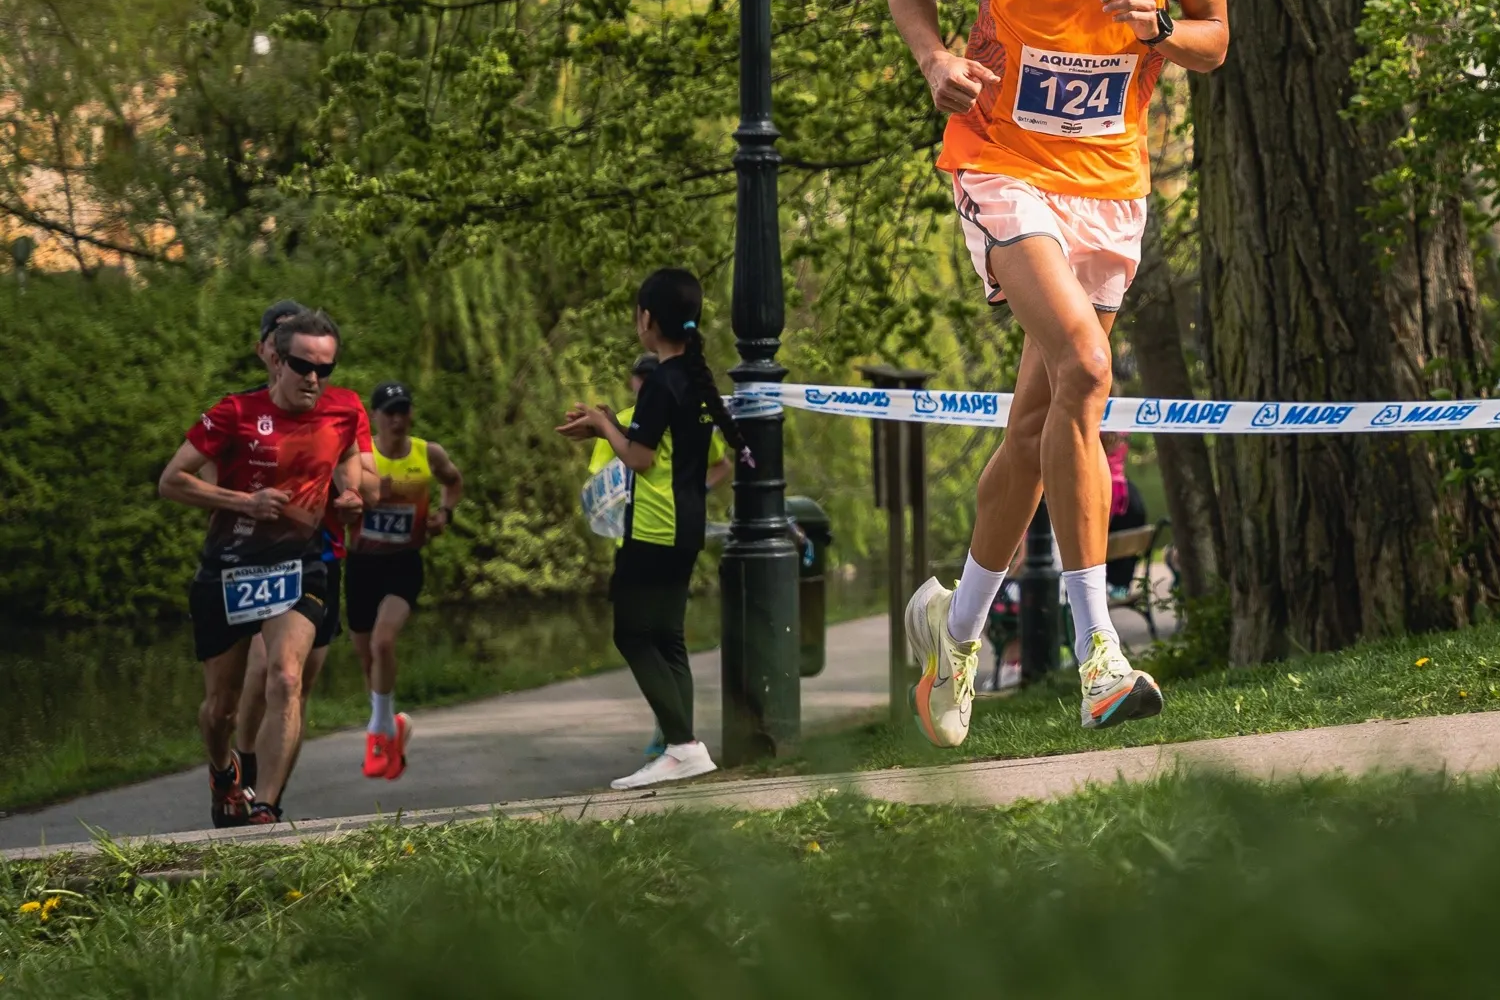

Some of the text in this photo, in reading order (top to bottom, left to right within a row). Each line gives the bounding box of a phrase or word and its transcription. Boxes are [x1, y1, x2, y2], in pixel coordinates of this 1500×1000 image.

[1039, 54, 1121, 69] AQUATLON
[1040, 76, 1109, 116] 124
[940, 393, 998, 415] MAPEI
[1164, 402, 1232, 424] MAPEI
[1401, 405, 1478, 423] MAPEI
[1280, 405, 1354, 424] MAPEI
[371, 514, 406, 532] 174
[237, 577, 286, 608] 241
